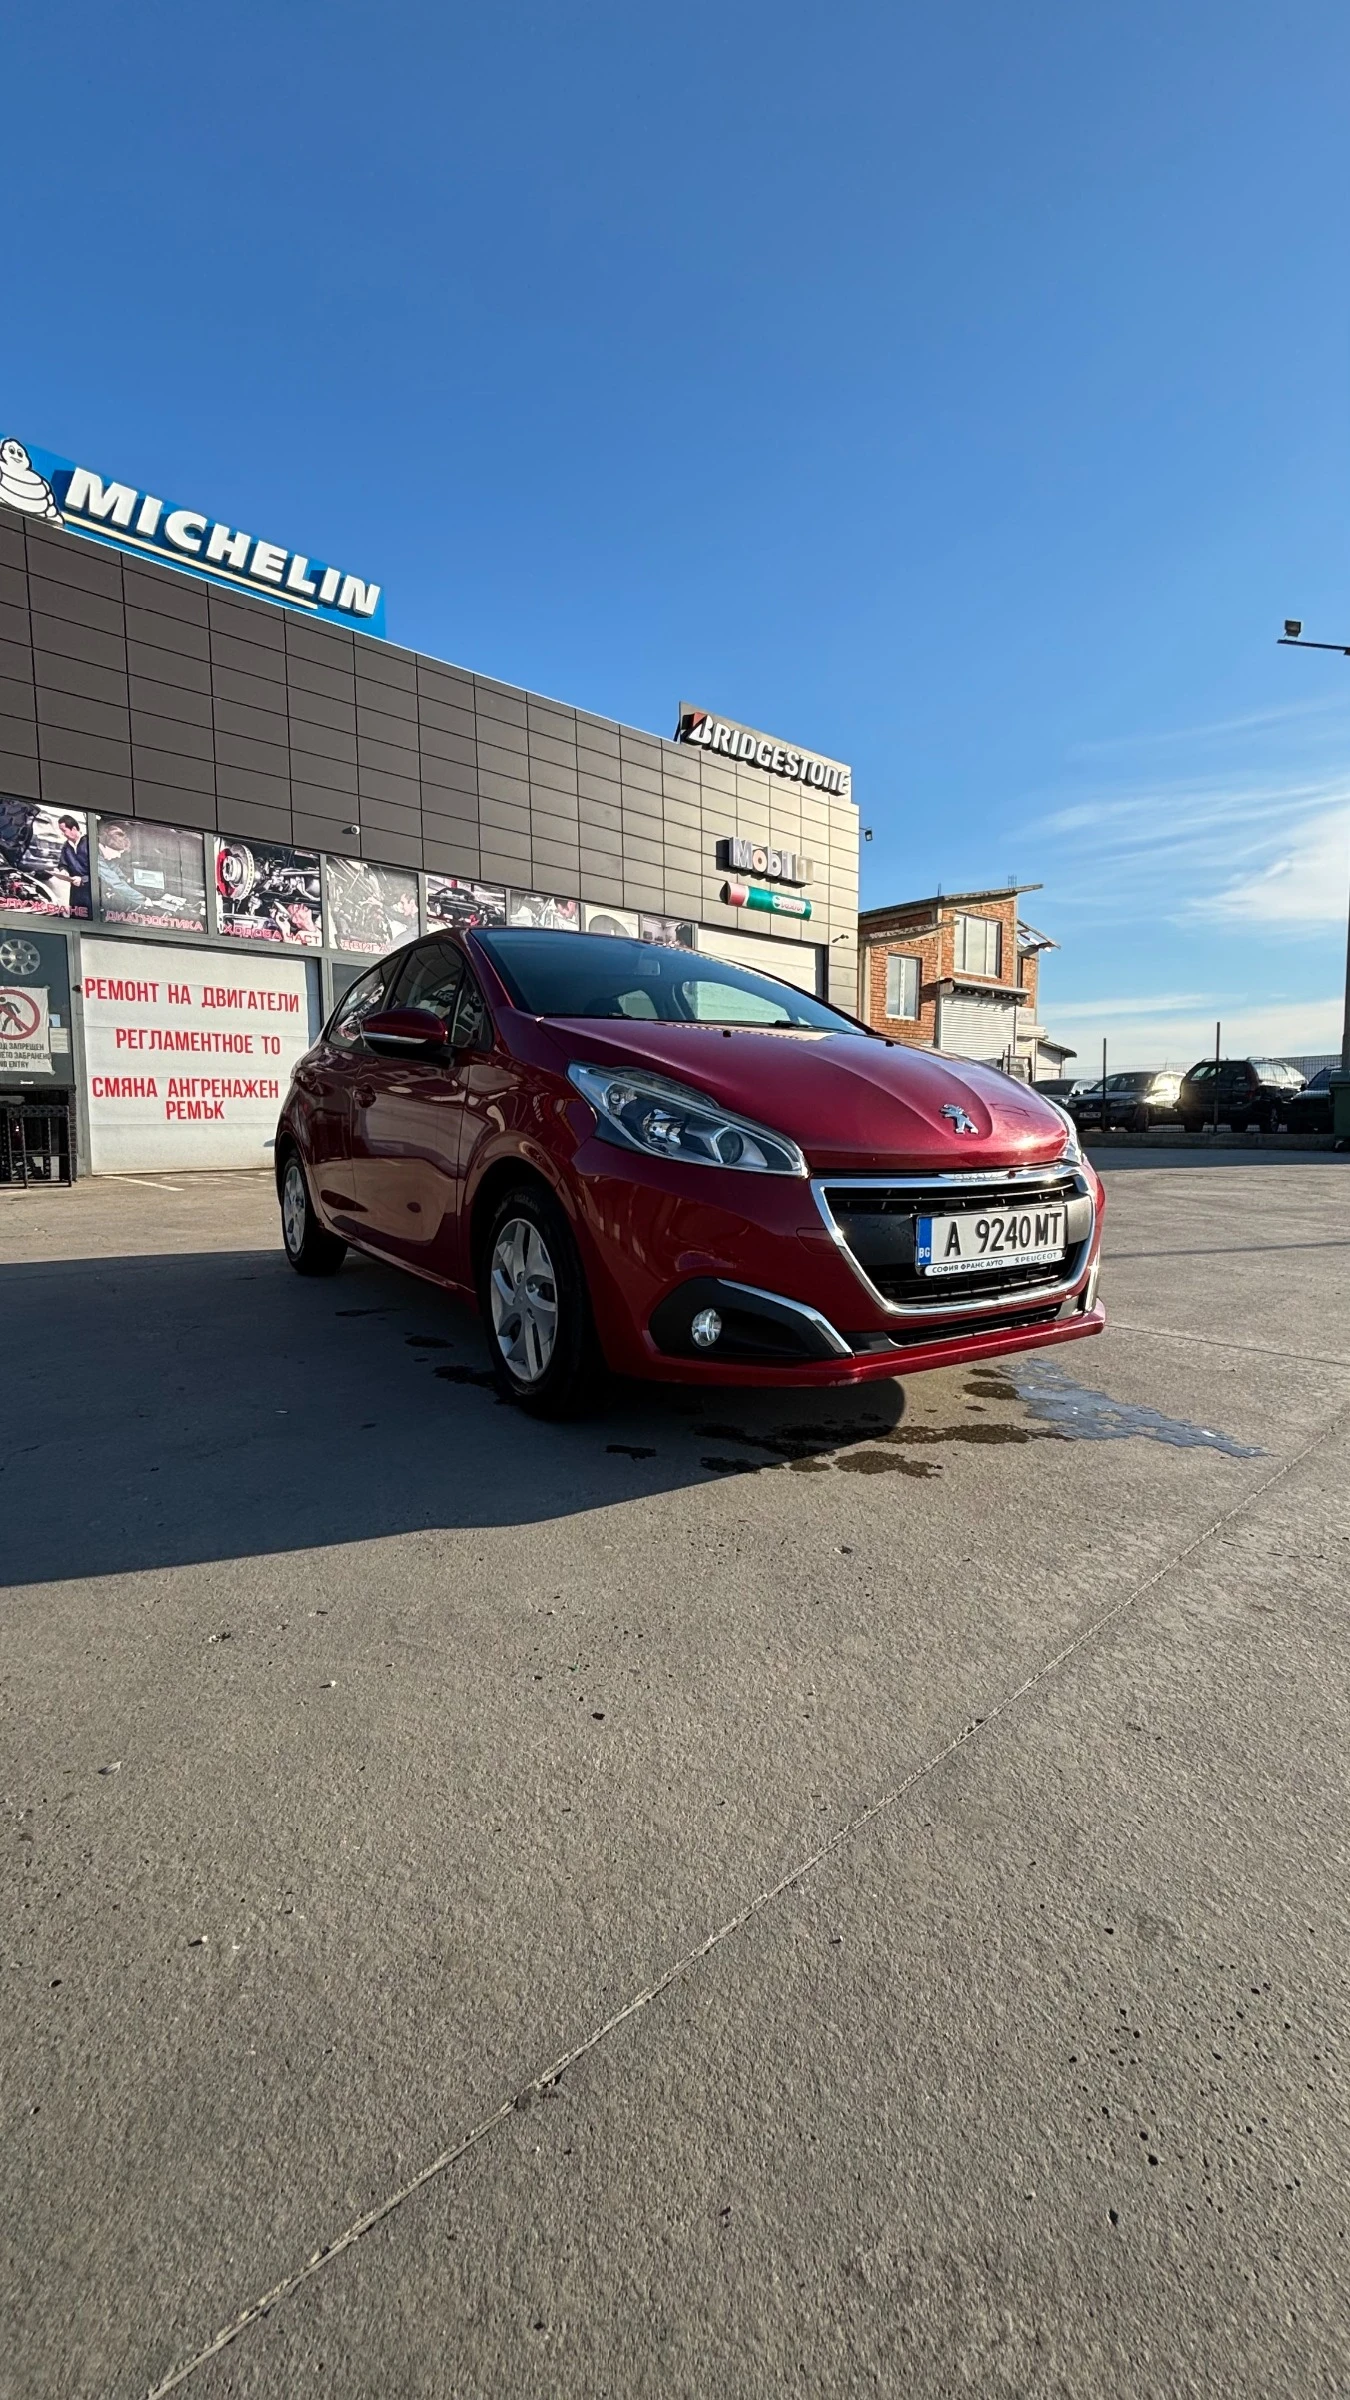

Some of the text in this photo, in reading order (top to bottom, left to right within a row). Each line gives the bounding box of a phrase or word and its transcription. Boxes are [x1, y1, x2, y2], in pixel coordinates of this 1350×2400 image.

[64, 466, 381, 618] MICHELIN
[688, 711, 852, 795] BRIDGESTONE
[729, 837, 793, 881] Mobil
[104, 910, 204, 932] ДИАГНОСТИКА
[286, 932, 320, 945] ЧАСТ
[84, 977, 299, 1013] РЕМОНТ НА ДВИГАТЕЛИ
[115, 1028, 281, 1055] РЕГЛАМЕНТНОЕ ТО
[92, 1077, 279, 1099] СМЯНА АНГРЕНАЖЕН
[165, 1100, 225, 1120] РЕМЪК
[944, 1220, 961, 1257] A
[918, 1247, 931, 1259] BG
[1020, 1251, 1058, 1262] PEUGEOT
[932, 1259, 1004, 1274] СОФИЯ ФРАНС АУТО
